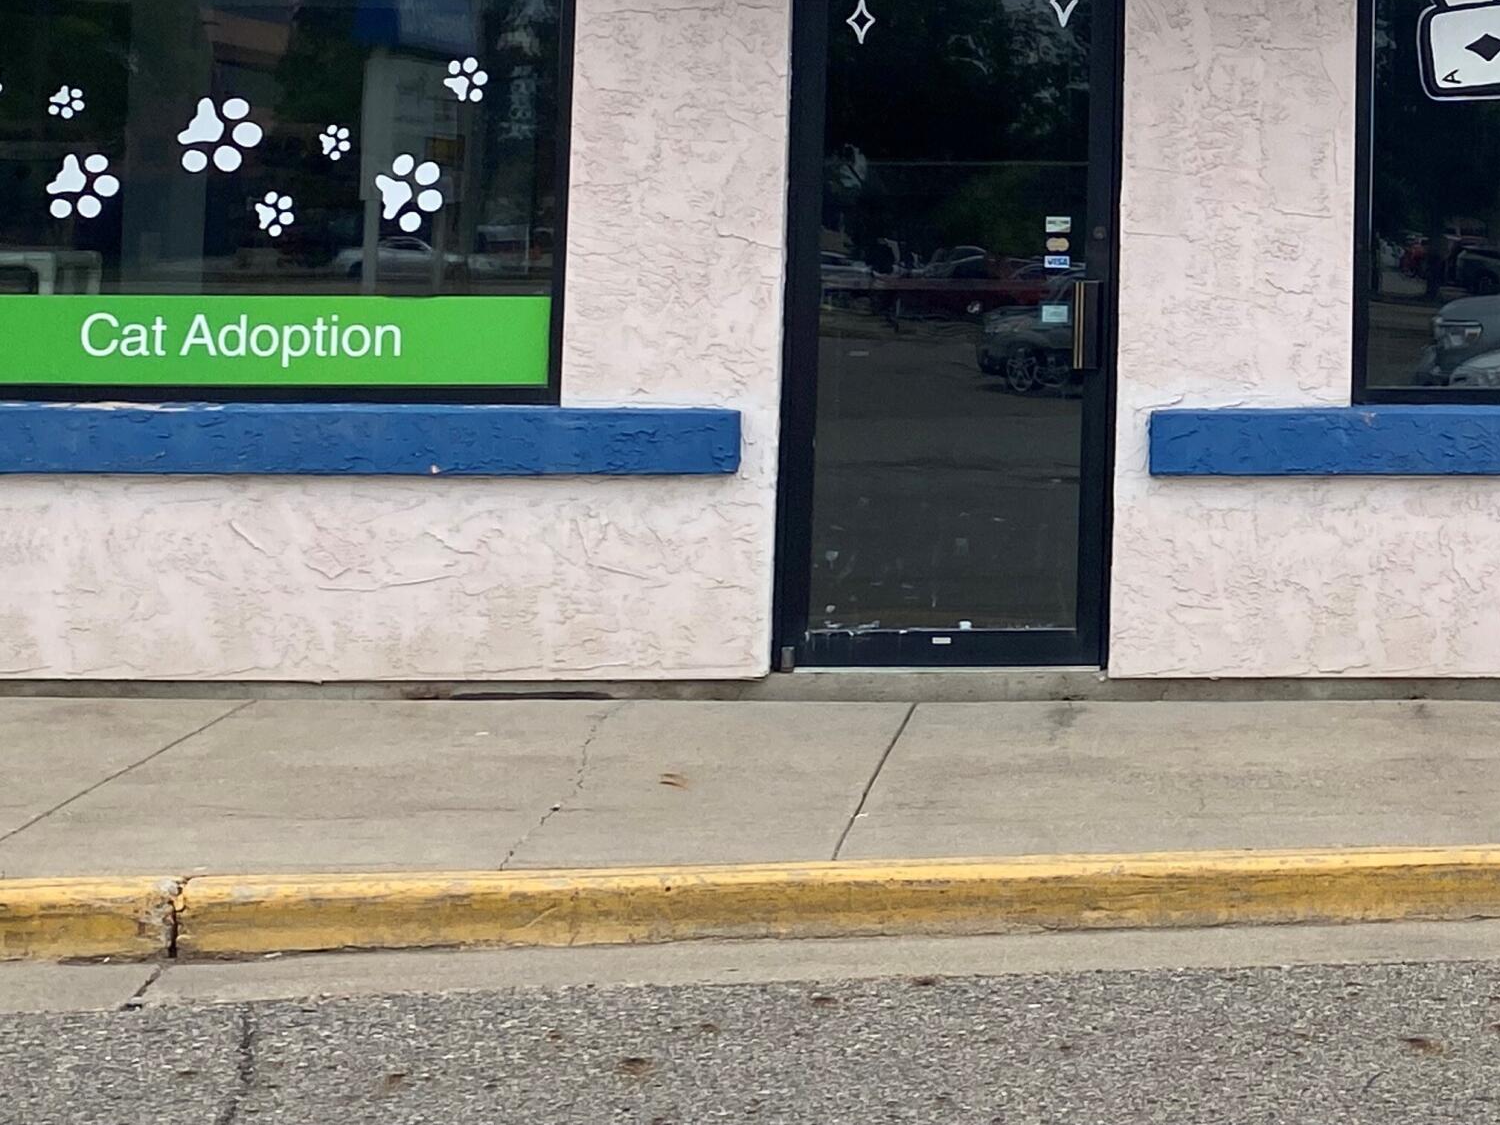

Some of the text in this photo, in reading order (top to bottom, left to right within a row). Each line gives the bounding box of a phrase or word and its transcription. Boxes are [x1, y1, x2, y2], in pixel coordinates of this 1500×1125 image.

[1442, 69, 1462, 84] A
[80, 312, 402, 368] Cat Adoption
